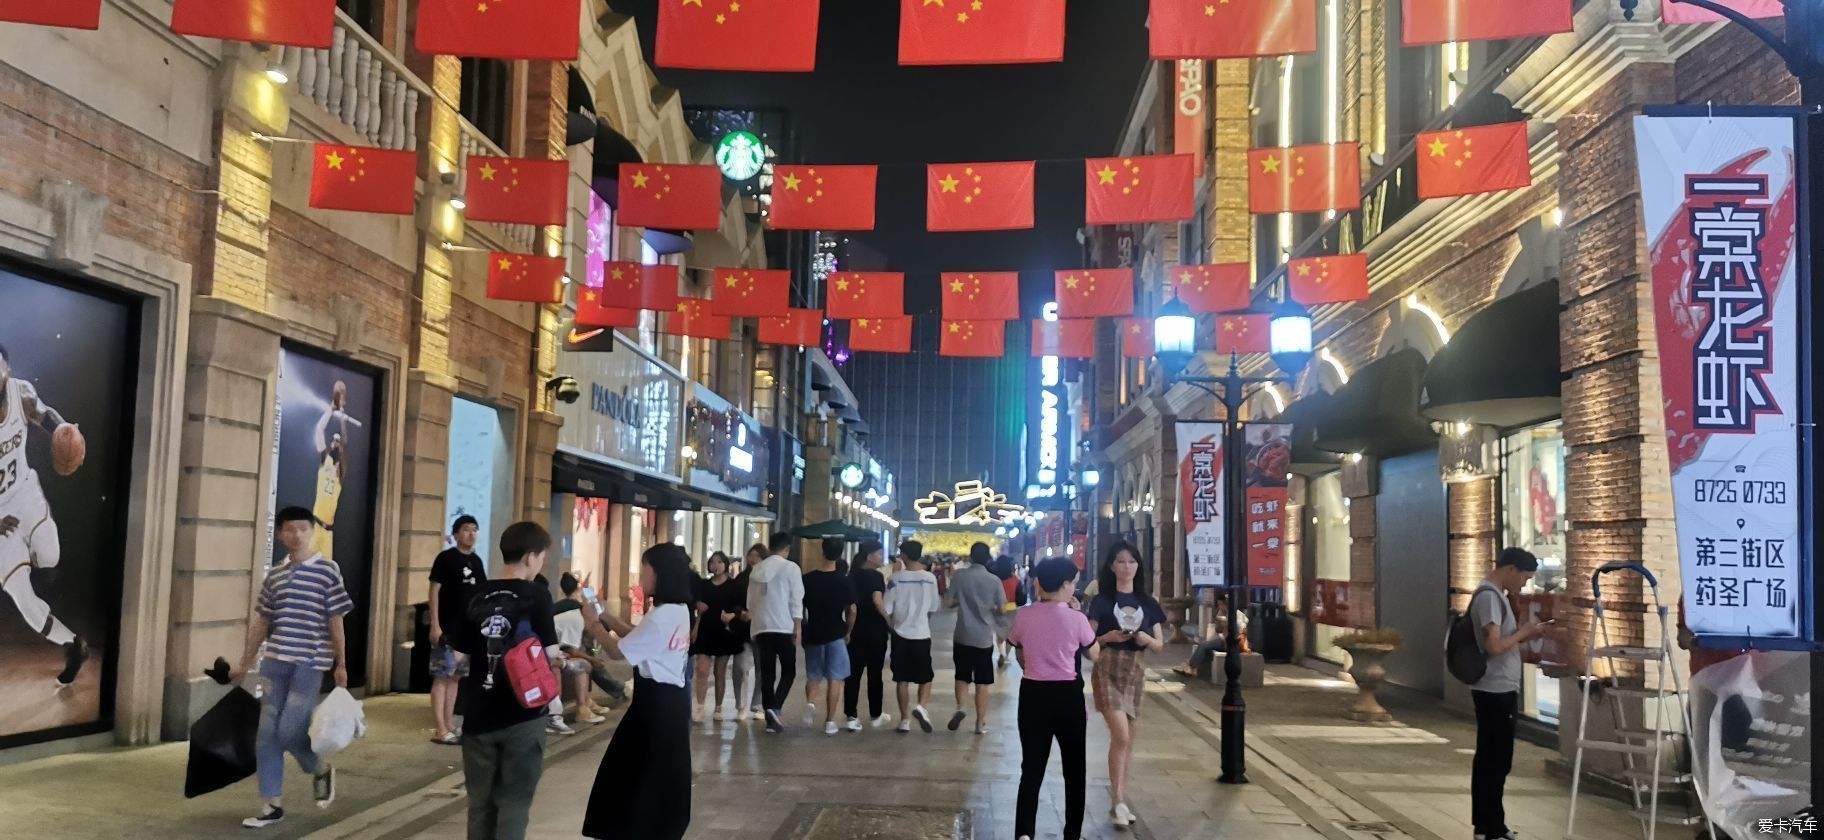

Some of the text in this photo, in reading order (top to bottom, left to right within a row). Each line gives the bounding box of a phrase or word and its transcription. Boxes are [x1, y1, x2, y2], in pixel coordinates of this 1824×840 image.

[1695, 479, 1786, 504] 8725 0733
[1695, 537, 1786, 568] 第三街区
[1695, 576, 1787, 608] 药圣广场
